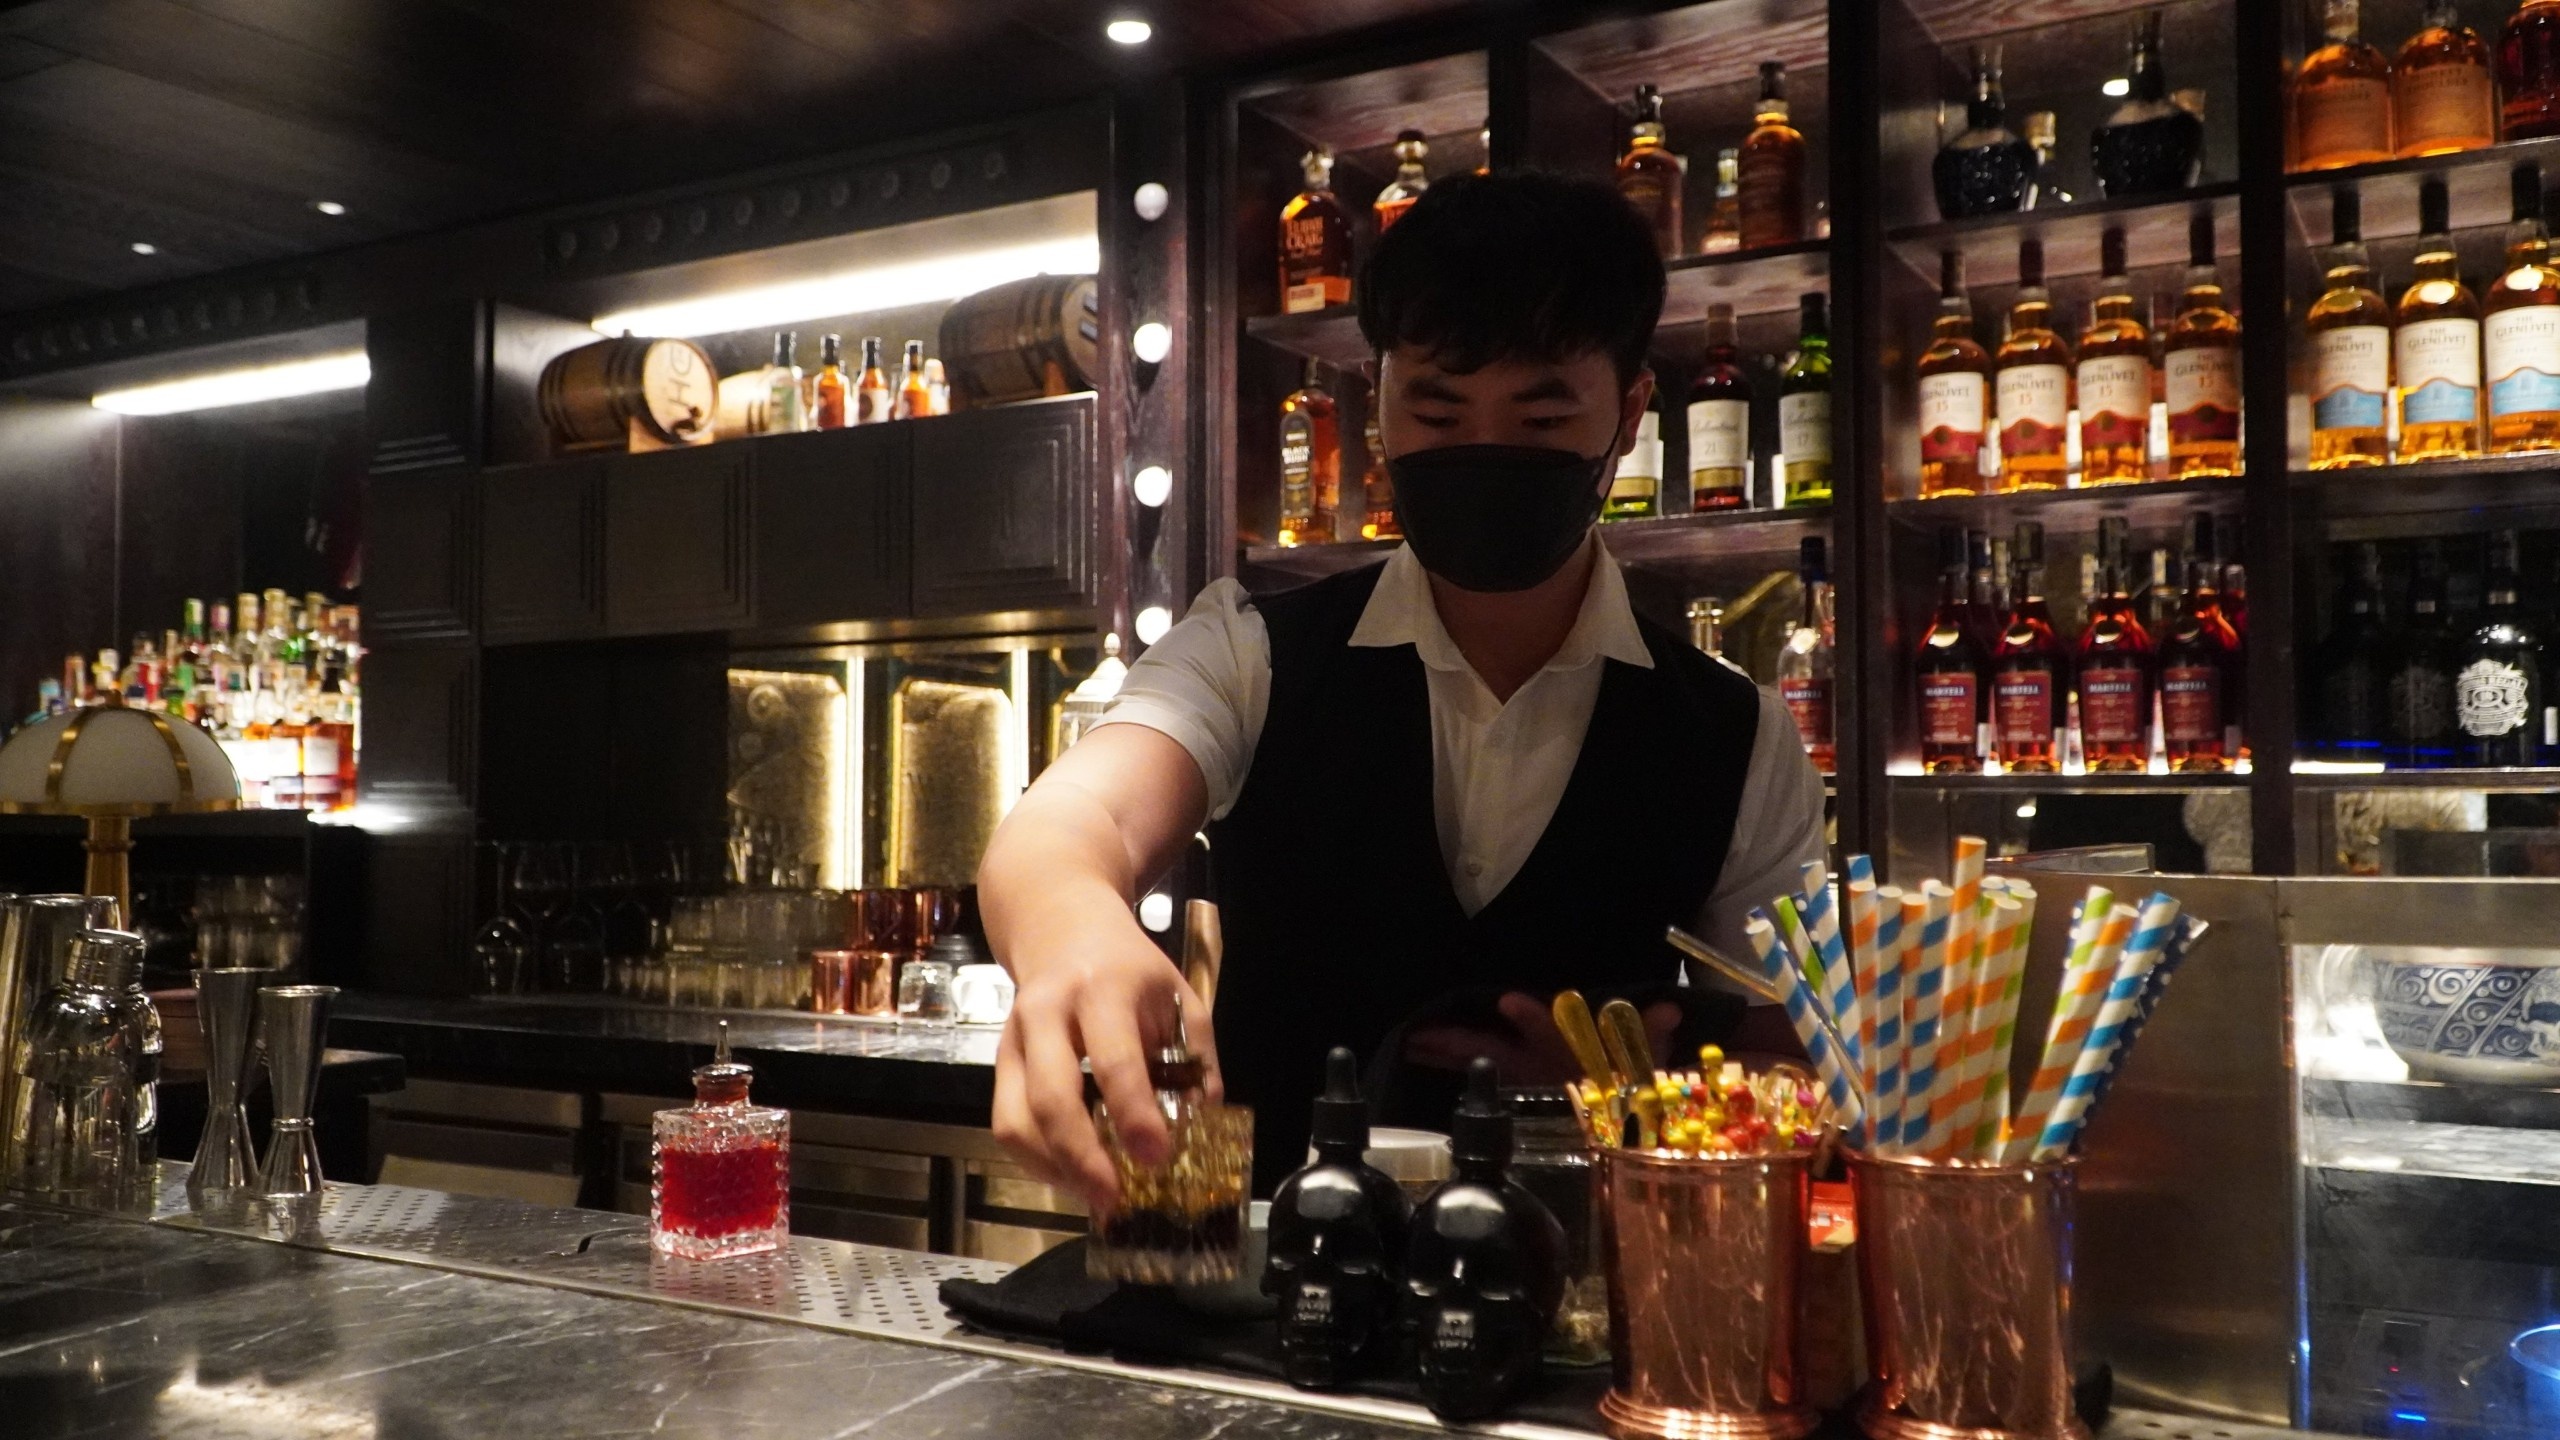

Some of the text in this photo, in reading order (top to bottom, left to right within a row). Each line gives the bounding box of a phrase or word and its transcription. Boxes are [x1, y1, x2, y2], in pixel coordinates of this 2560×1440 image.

[2495, 322, 2555, 339] GLENLIVET
[2320, 341, 2373, 353] ENLIVET
[2408, 335, 2466, 349] GLENLIVET
[2081, 370, 2135, 386] GLENLIVET
[2100, 385, 2113, 397] 15
[2020, 393, 2033, 405] 15
[1936, 401, 1949, 413] 15
[1282, 445, 1310, 457] BLACK
[1284, 454, 1308, 464] BUSH
[1926, 686, 1965, 696] MARTELL
[2000, 685, 2039, 695] MARTELL
[2088, 683, 2132, 693] MARTELL
[2166, 682, 2207, 692] MARTELL
